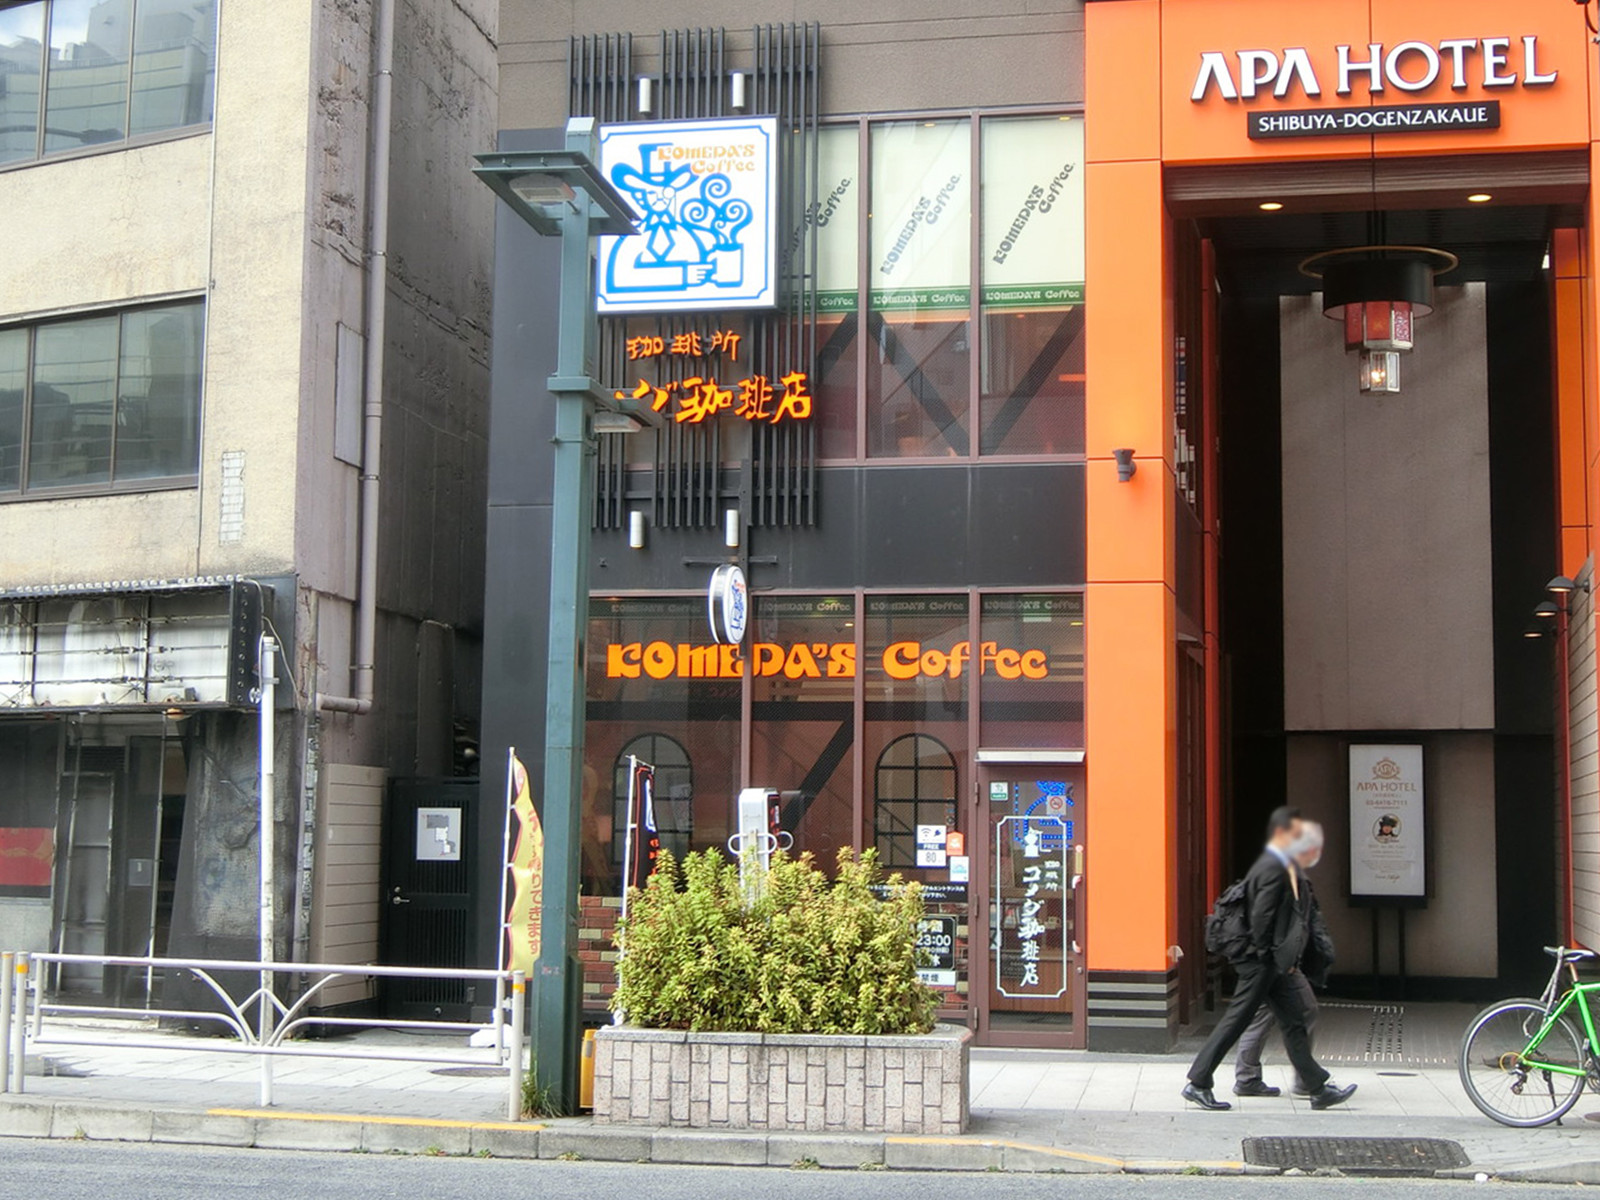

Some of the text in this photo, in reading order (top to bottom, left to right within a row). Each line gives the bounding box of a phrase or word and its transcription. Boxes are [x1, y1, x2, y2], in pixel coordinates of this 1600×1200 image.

[1190, 36, 1559, 101] APA HOTEL
[1258, 106, 1488, 133] SHIBUYA-DOGENZAKAUE
[658, 144, 755, 161] KOMEDA'S
[691, 161, 755, 174] Coffee
[925, 174, 961, 226] Coffee
[1038, 162, 1075, 215] Coffee
[992, 184, 1045, 265] KOMEDA'S
[626, 330, 741, 361] 珈琲所
[606, 641, 1048, 680] KOMEDA'S Coffee
[1357, 782, 1417, 791] APA HOTEL
